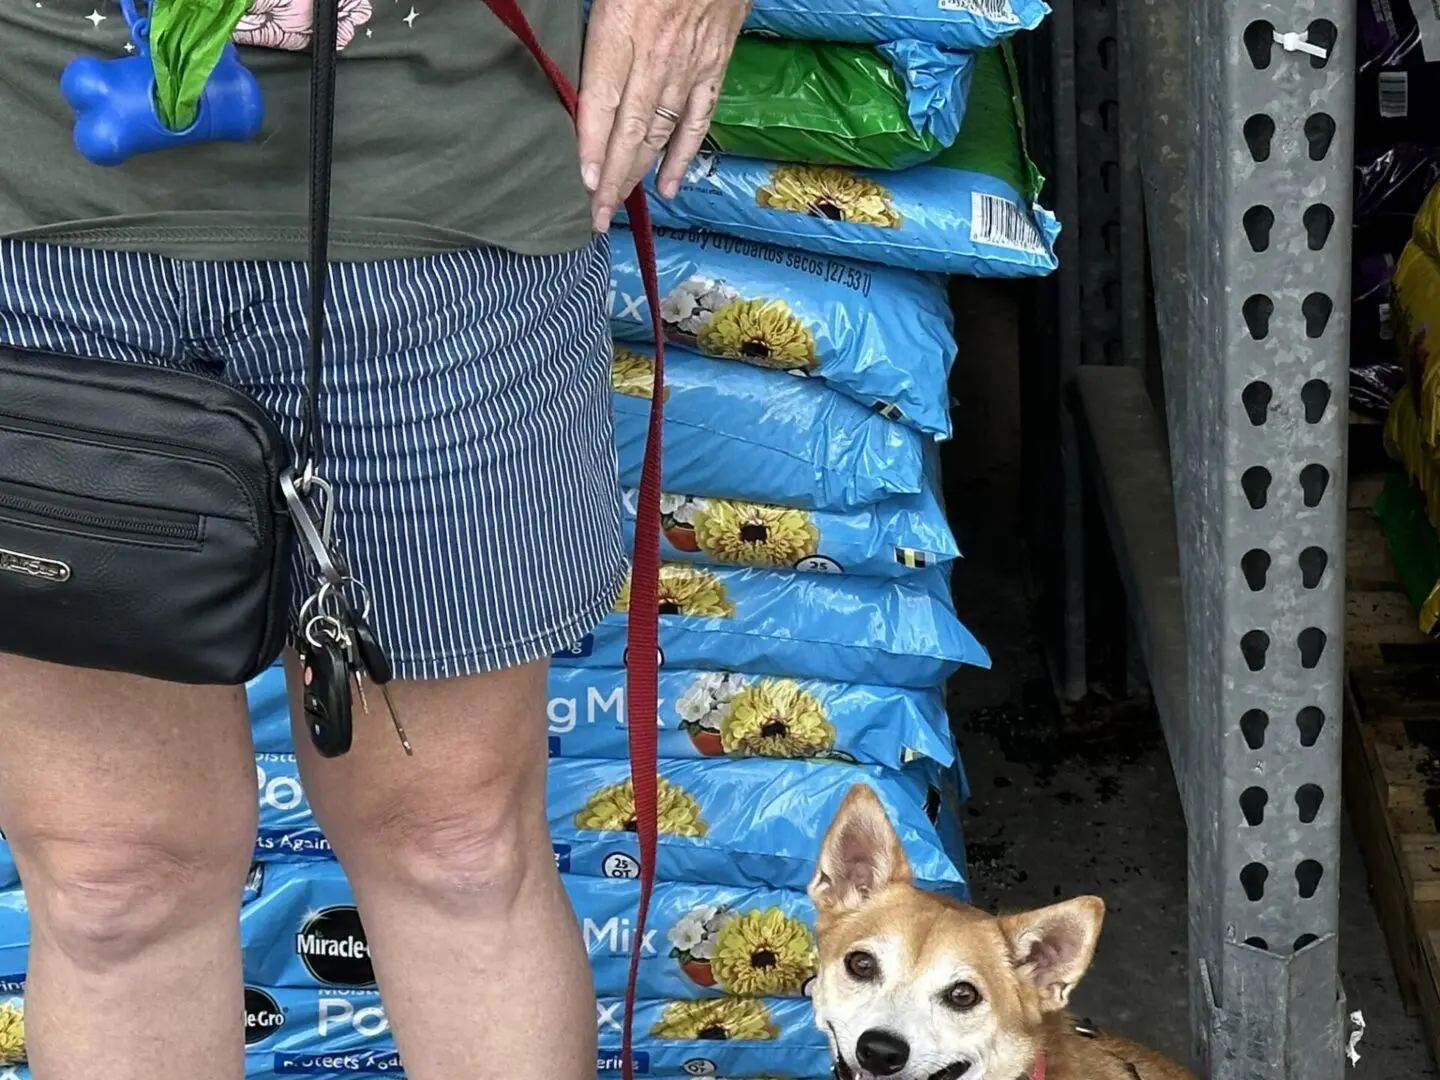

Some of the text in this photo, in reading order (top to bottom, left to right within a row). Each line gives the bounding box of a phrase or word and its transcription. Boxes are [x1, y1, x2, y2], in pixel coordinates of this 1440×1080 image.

[785, 251, 823, 276] secos
[613, 857, 629, 870] 25
[297, 934, 372, 959] Miracle-
[582, 916, 658, 954] Mix
